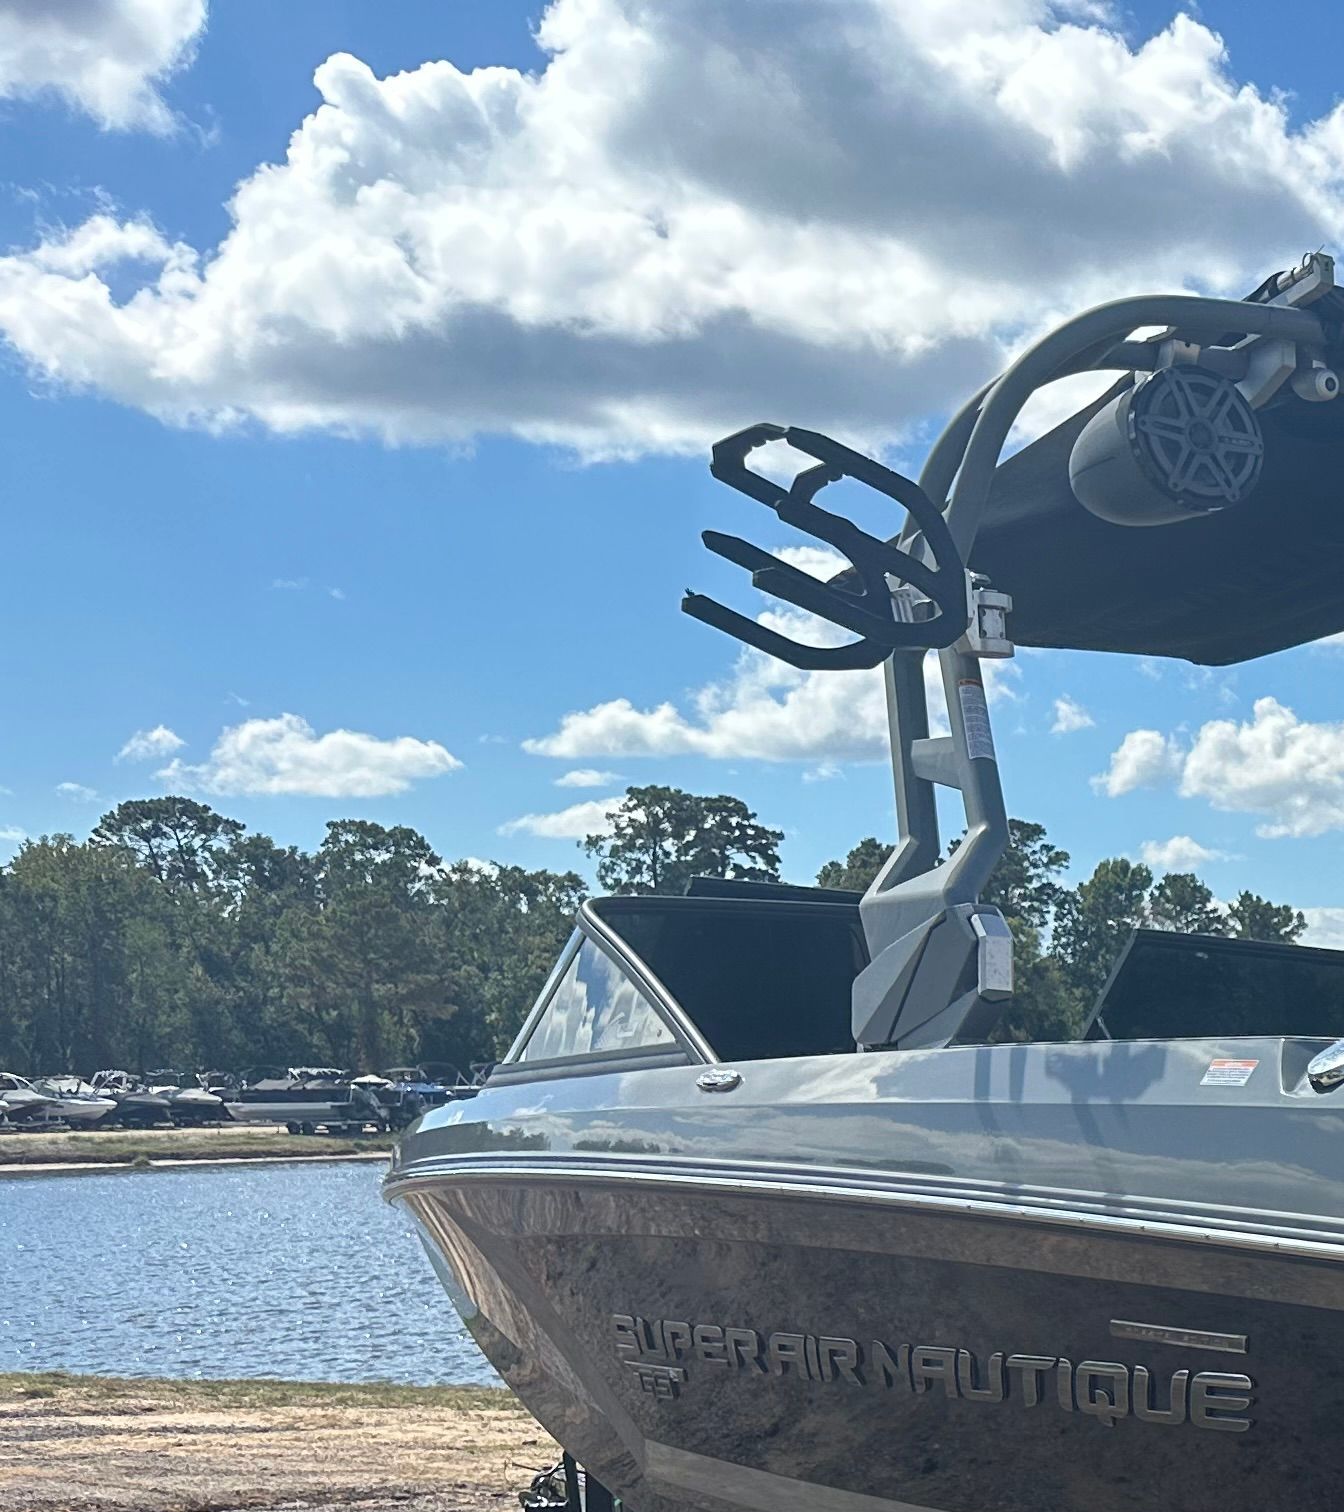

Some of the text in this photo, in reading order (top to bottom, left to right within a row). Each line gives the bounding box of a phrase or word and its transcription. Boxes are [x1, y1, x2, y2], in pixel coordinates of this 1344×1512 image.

[611, 1313, 1252, 1433] SUPER AIR NAUTIQUE
